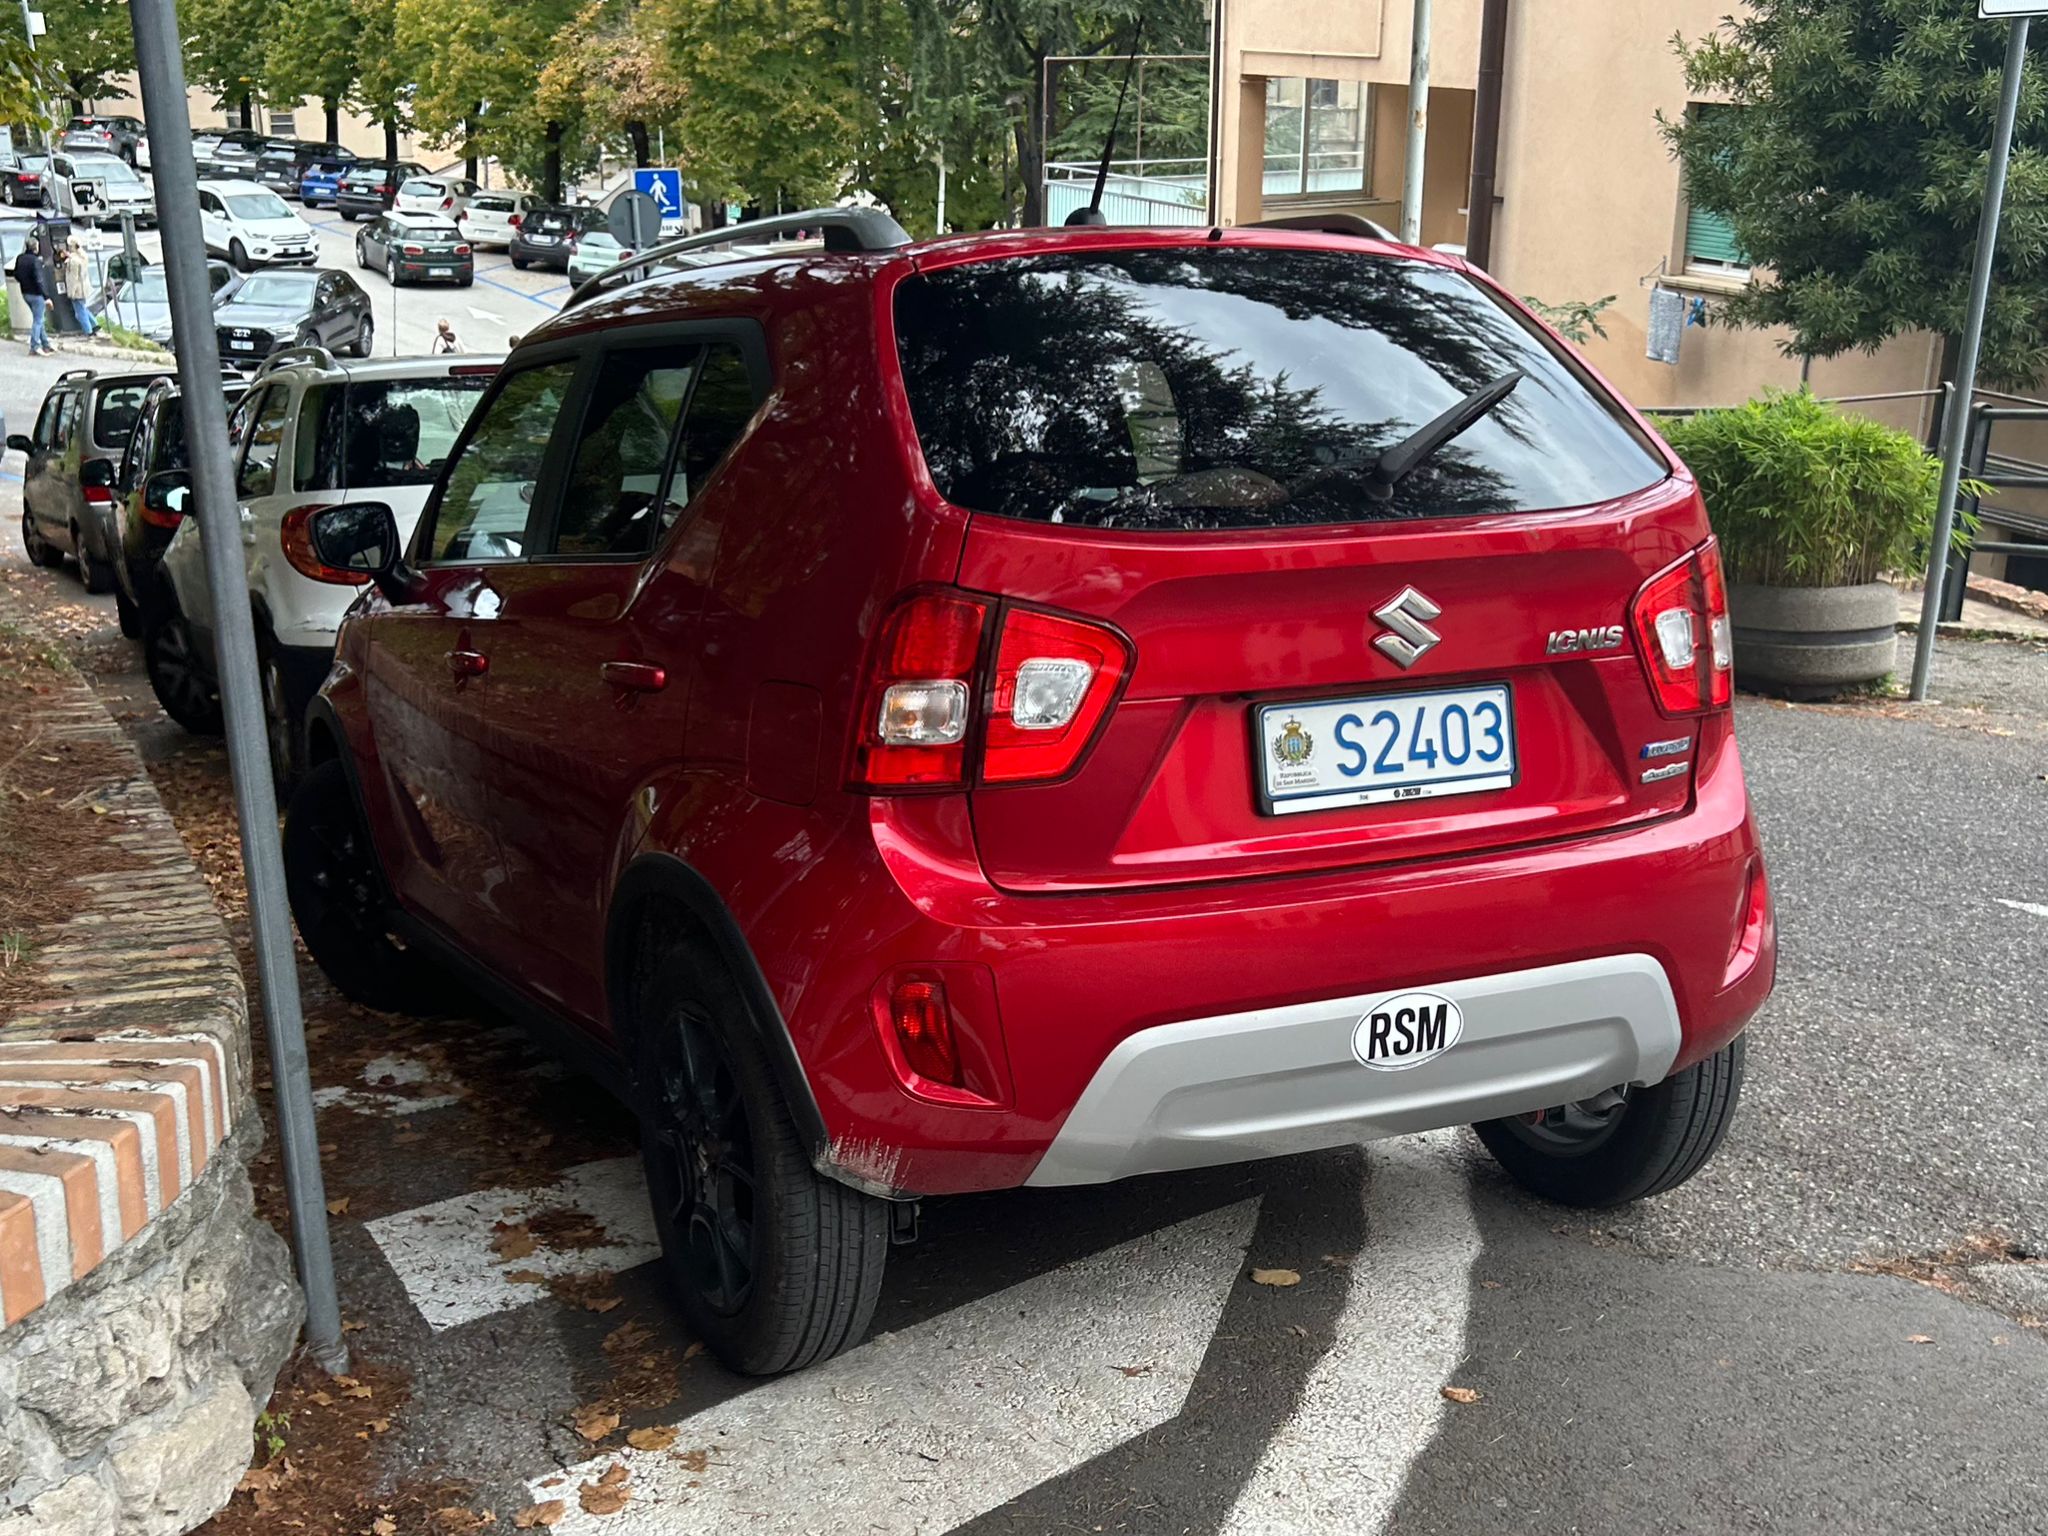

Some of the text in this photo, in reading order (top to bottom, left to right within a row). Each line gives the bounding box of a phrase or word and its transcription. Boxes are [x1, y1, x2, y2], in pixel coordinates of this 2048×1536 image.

[1545, 625, 1625, 656] IGNIS
[1333, 700, 1505, 777] S2403
[1367, 1003, 1448, 1060] RSM
